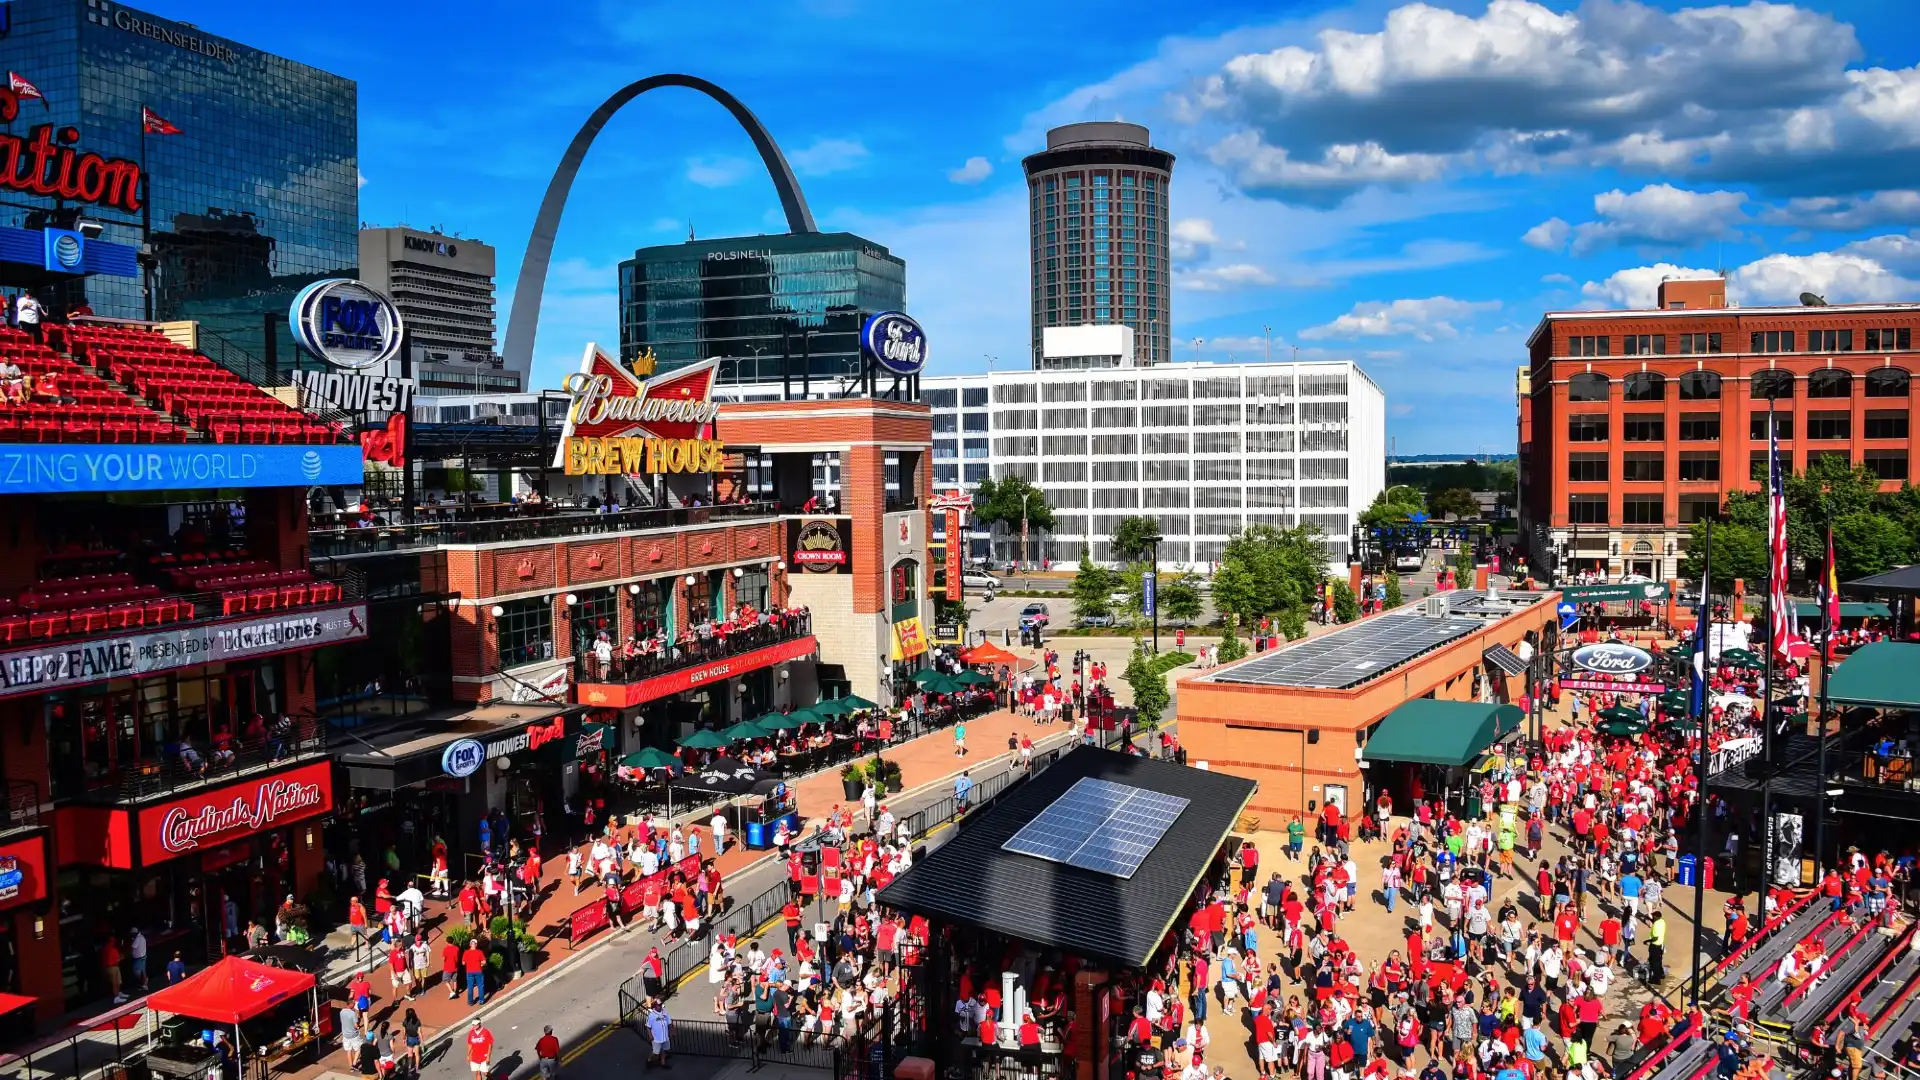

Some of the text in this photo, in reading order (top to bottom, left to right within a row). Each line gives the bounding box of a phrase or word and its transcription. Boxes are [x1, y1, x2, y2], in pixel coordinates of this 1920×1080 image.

[115, 10, 236, 64] GREENSFELDER
[404, 235, 435, 253] KMOV
[707, 249, 771, 262] POLSINELLI
[321, 295, 382, 337] FOX
[326, 332, 384, 351] SPORTS
[884, 320, 921, 364] Ford
[291, 369, 414, 412] MIDWEST
[563, 372, 721, 425] Budweiser
[565, 436, 725, 475] BREW HOUSE
[4, 453, 257, 484] ZING YOUR WORLD
[797, 552, 842, 560] CROWN ROOM
[68, 642, 133, 679] FAME
[139, 638, 200, 661] PRESENTED
[202, 636, 216, 651] BY
[279, 621, 322, 645] Jones
[1588, 649, 1636, 669] Ford
[690, 669, 709, 683] BREW
[710, 663, 730, 679] HOUSE
[1573, 681, 1651, 691] FORD PLAZA
[455, 746, 475, 763] FOX
[486, 732, 531, 760] MIDWEST
[456, 760, 476, 771] SPORTS
[162, 779, 320, 852] Cardinals Nation
[1593, 972, 1604, 983] 52
